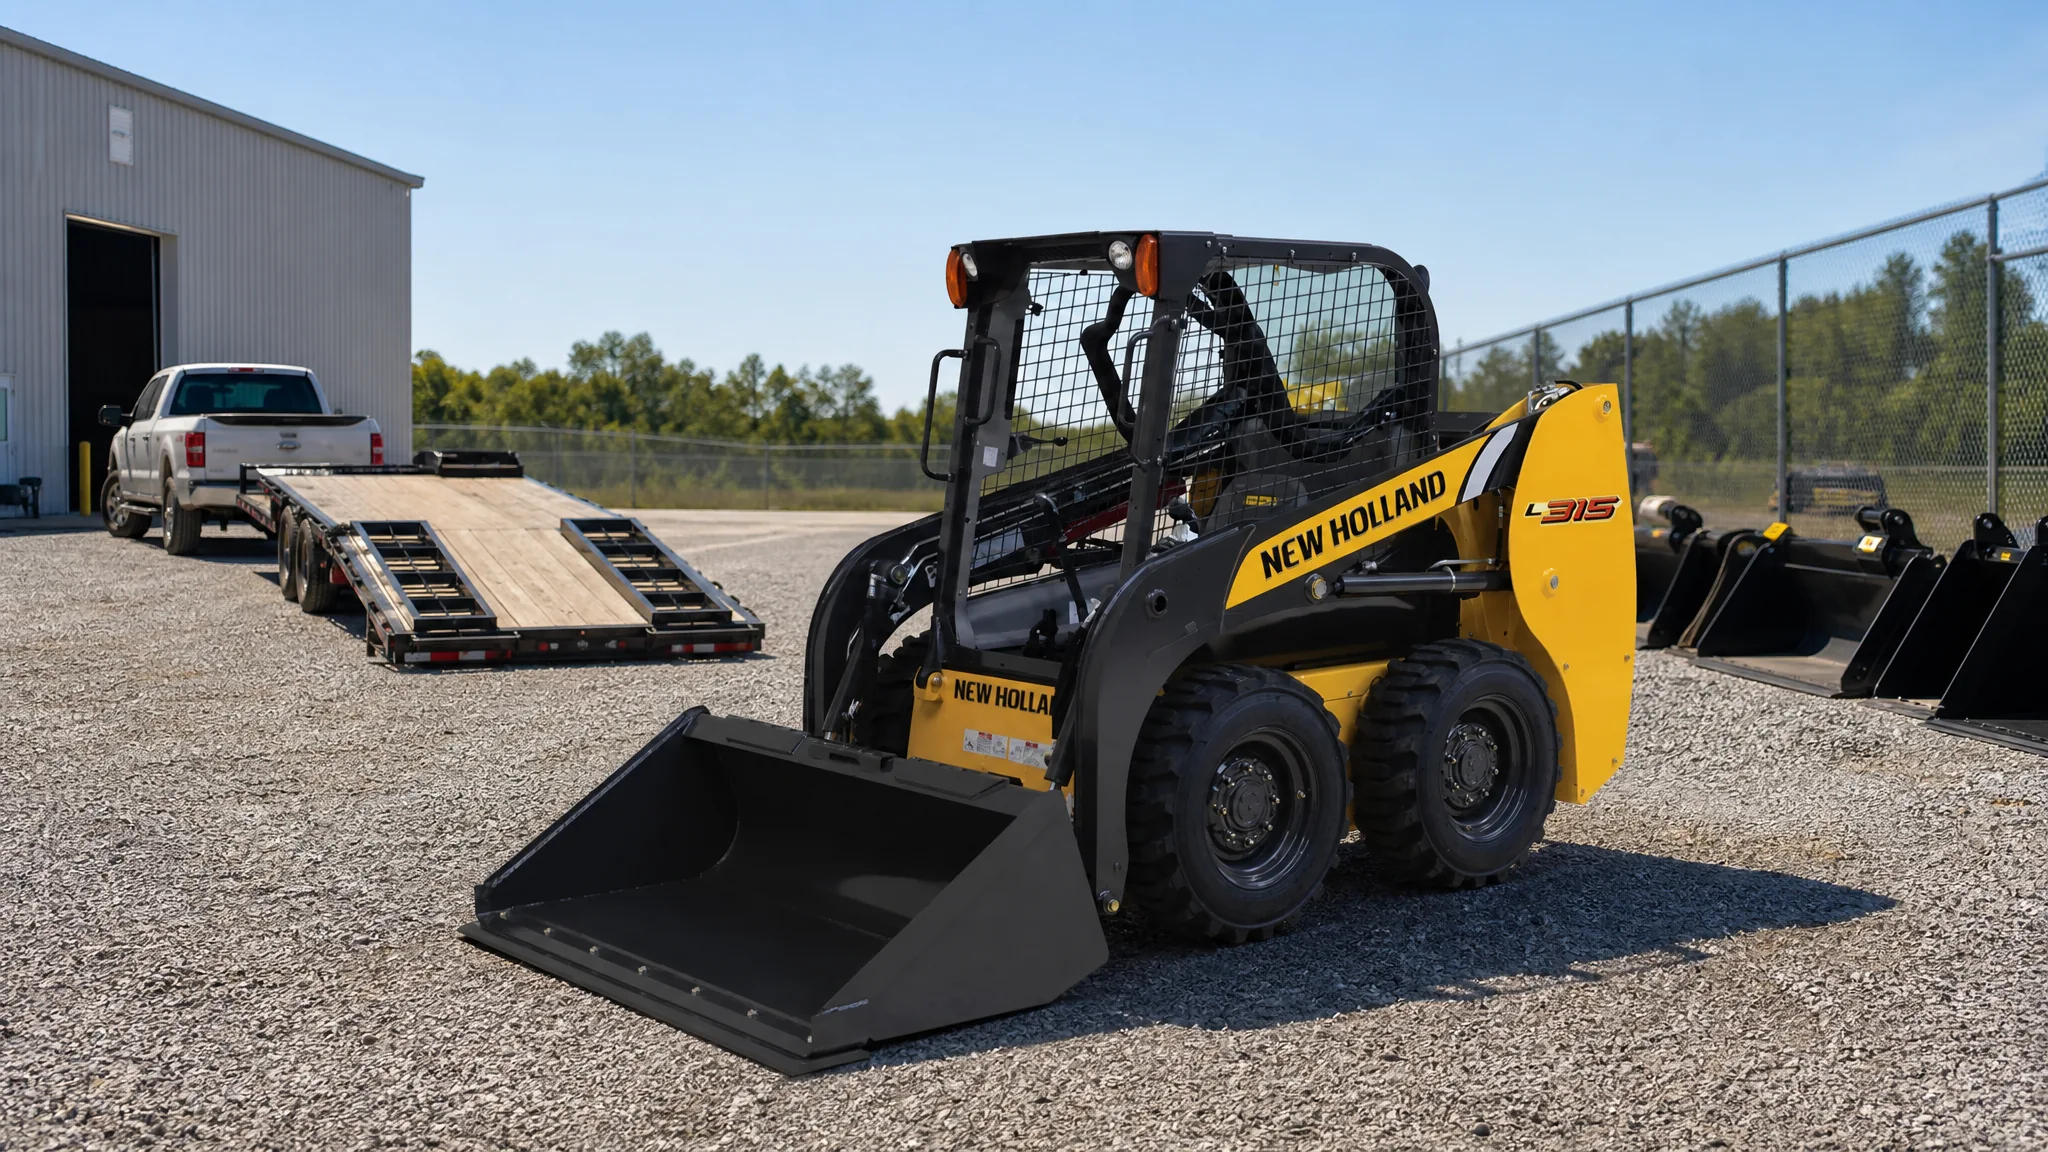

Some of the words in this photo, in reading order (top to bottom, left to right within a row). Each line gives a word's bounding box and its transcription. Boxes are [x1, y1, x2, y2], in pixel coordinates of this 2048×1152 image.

[1260, 525, 1323, 580] NEW
[1329, 470, 1446, 548] HOLLAND
[1524, 496, 1620, 524] L315
[954, 679, 992, 704] NEW
[995, 686, 1053, 716] HOLLA
